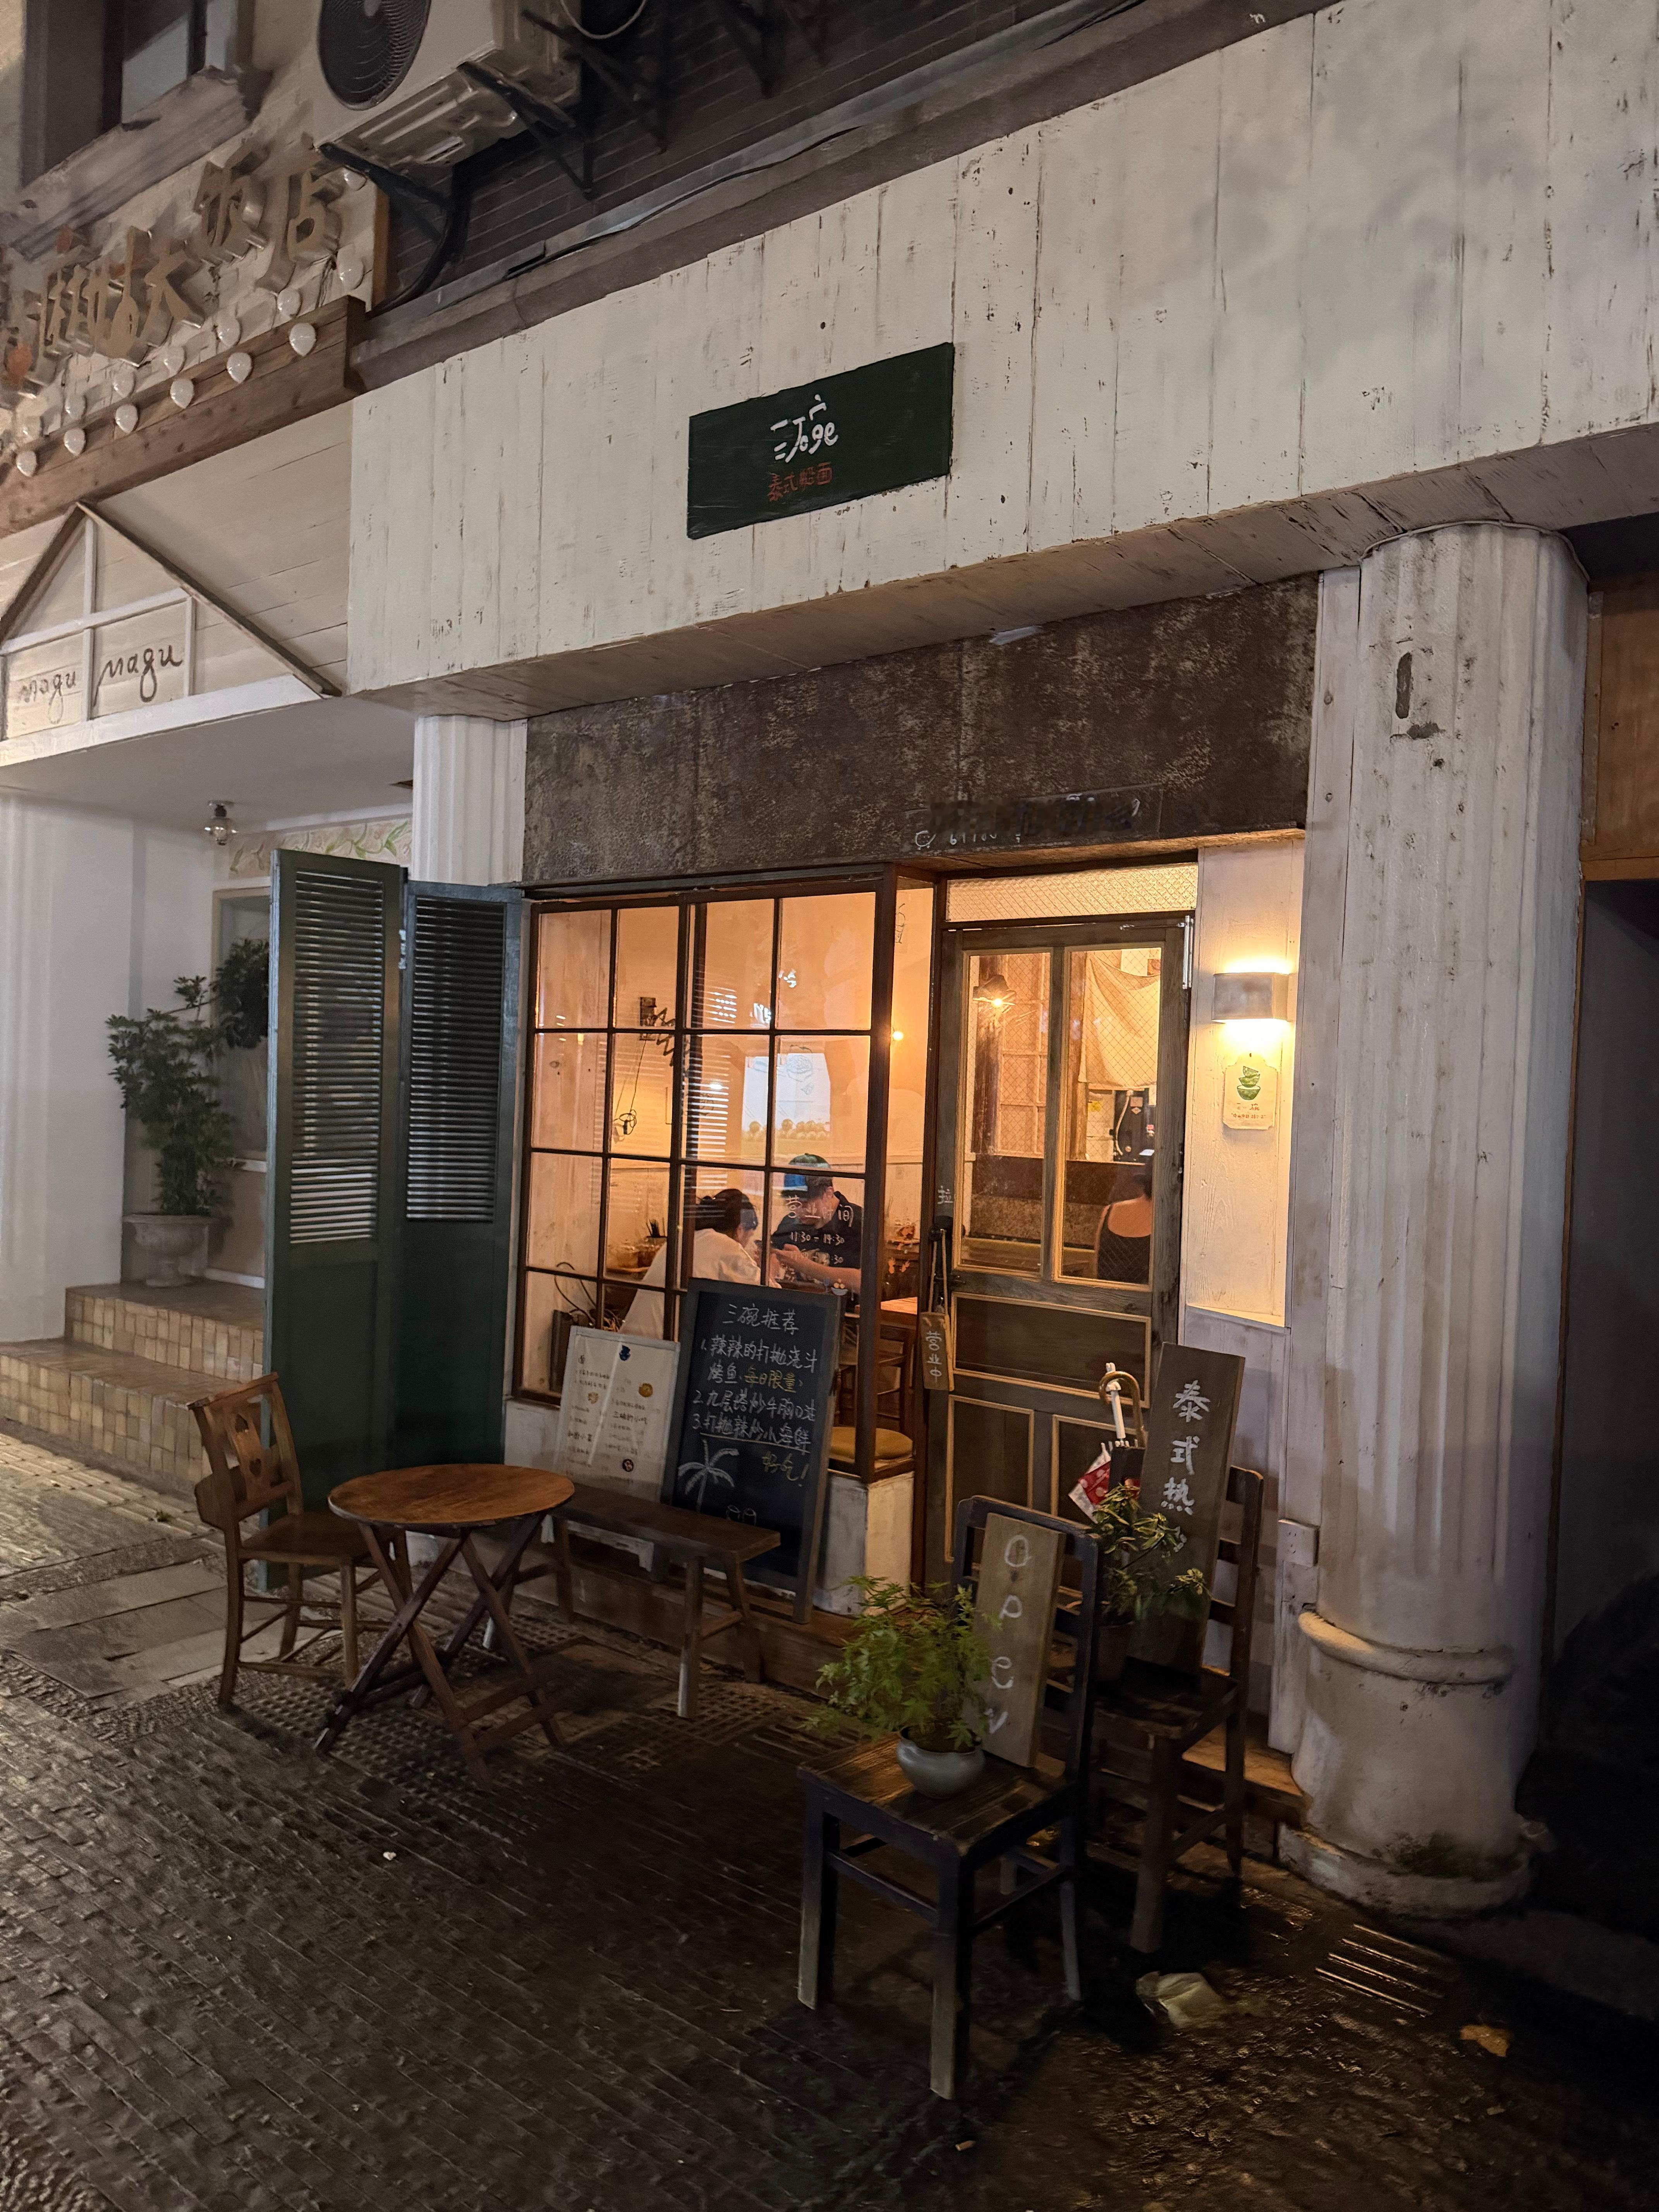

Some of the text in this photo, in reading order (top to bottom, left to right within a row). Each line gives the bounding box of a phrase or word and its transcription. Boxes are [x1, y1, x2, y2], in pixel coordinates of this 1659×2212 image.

[93, 645, 182, 702] magu
[937, 1185, 953, 1204] 拉
[722, 1303, 799, 1335] 三碗推荐
[926, 1331, 942, 1382] 营业中
